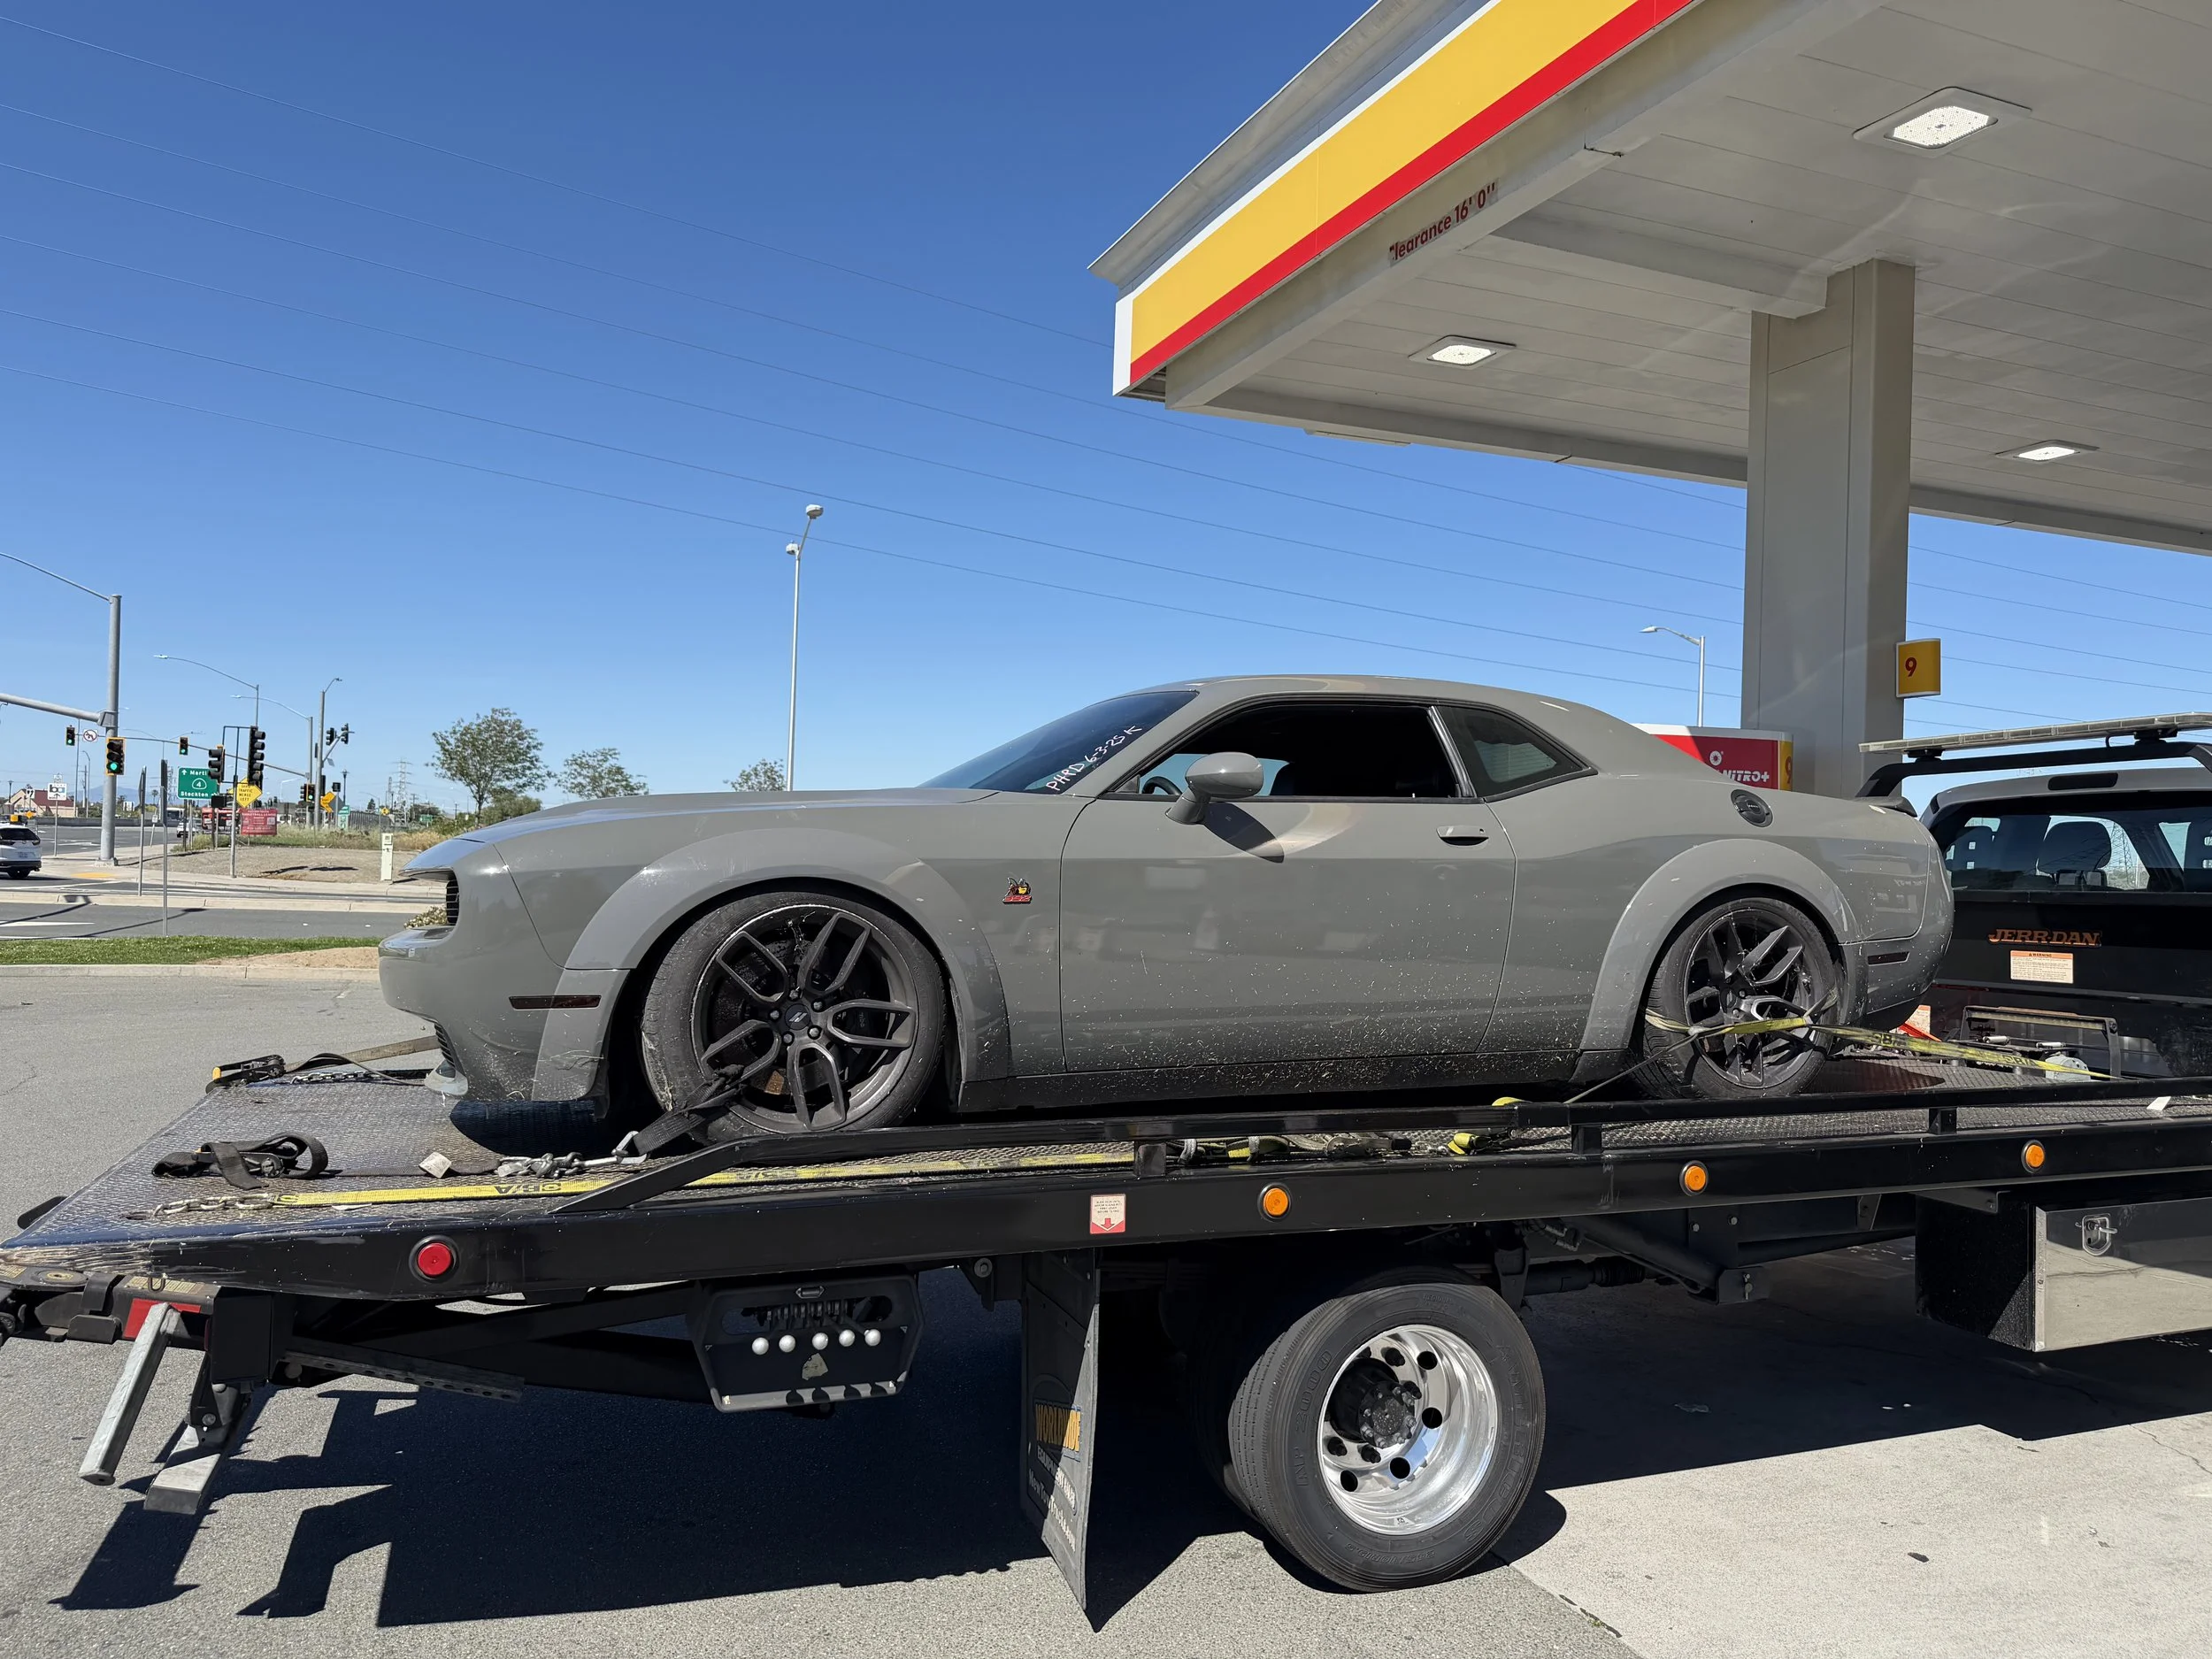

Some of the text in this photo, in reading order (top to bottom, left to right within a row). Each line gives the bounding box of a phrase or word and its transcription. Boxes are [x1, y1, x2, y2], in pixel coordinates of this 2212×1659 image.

[1389, 215, 1452, 261] learance
[1454, 197, 1473, 223] 16'
[1905, 657, 1917, 677] 9
[1294, 1349, 1333, 1433] 2000
[1035, 1402, 1082, 1453] WORLDWIDE
